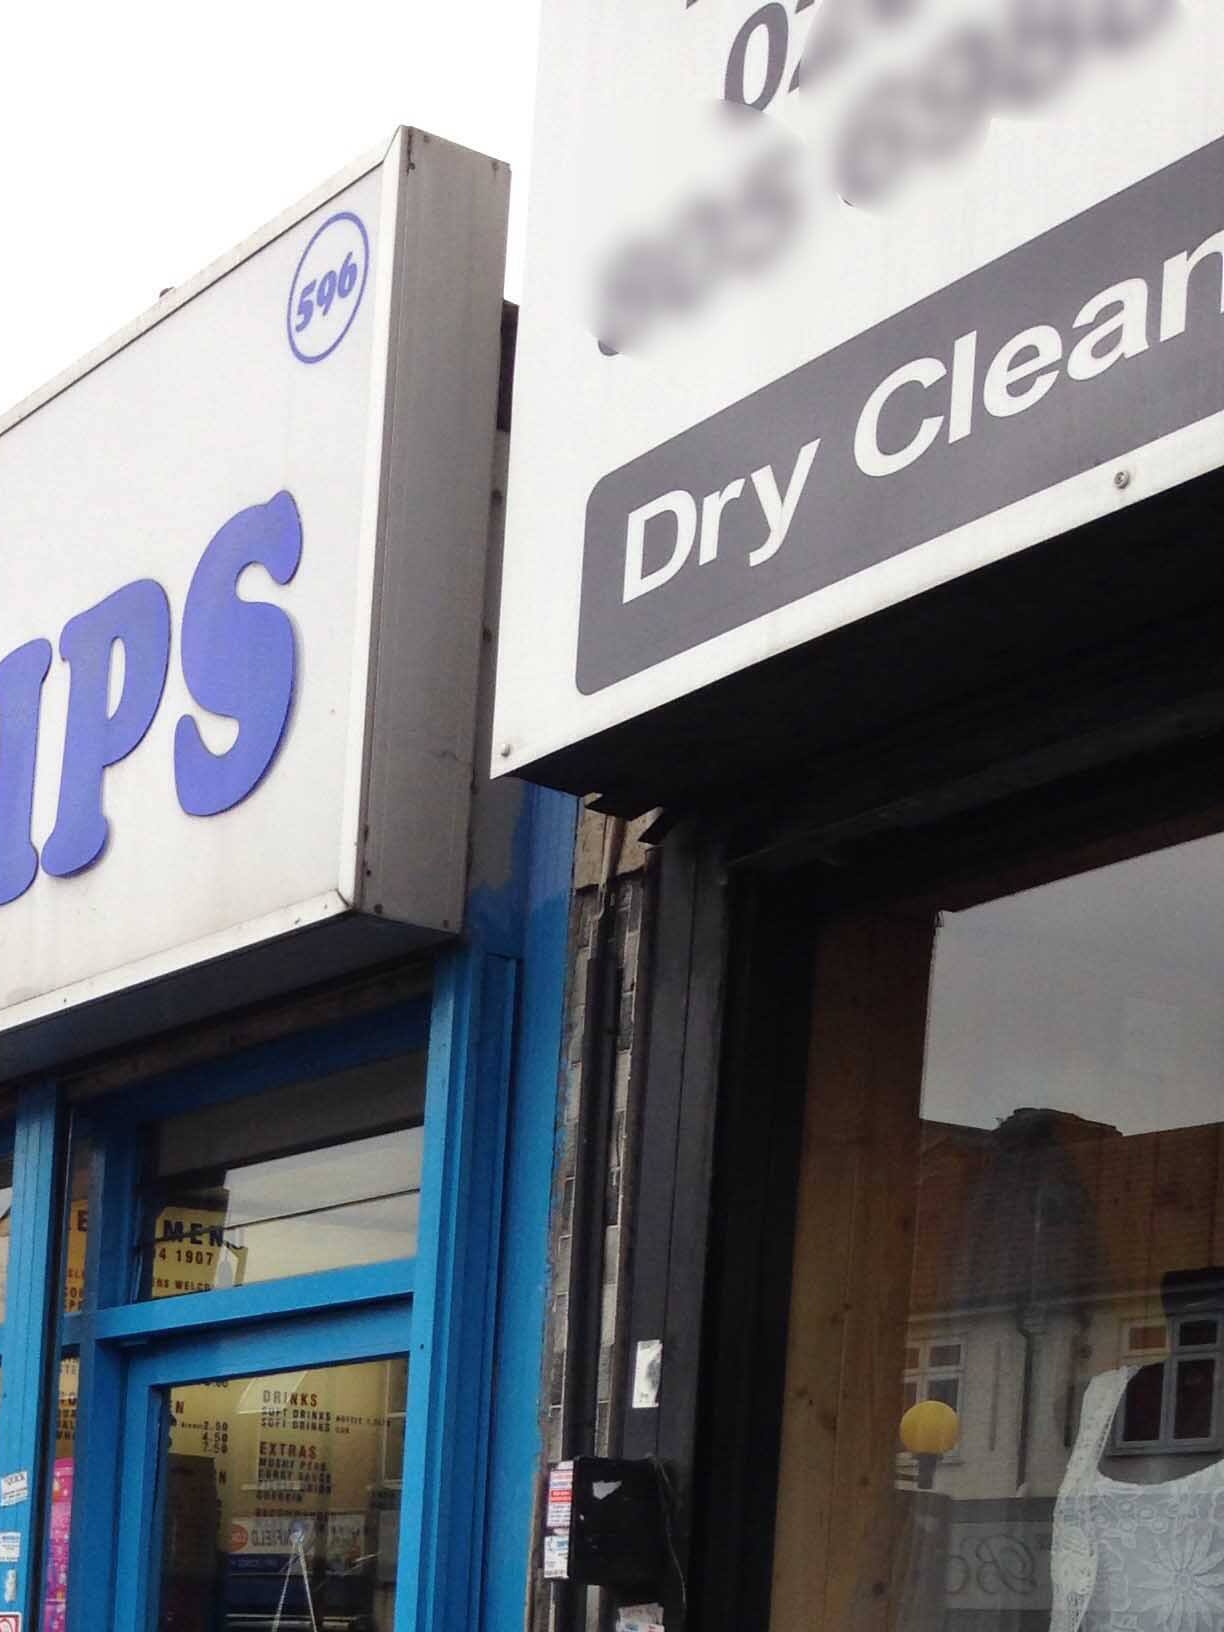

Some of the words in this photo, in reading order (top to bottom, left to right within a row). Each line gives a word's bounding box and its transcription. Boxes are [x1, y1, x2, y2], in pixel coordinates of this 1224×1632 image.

[295, 250, 358, 333] 596
[622, 437, 821, 604] Dry
[176, 1249, 214, 1266] 1907
[262, 1390, 319, 1408] DRINKS
[259, 1441, 318, 1460] EXTRAS
